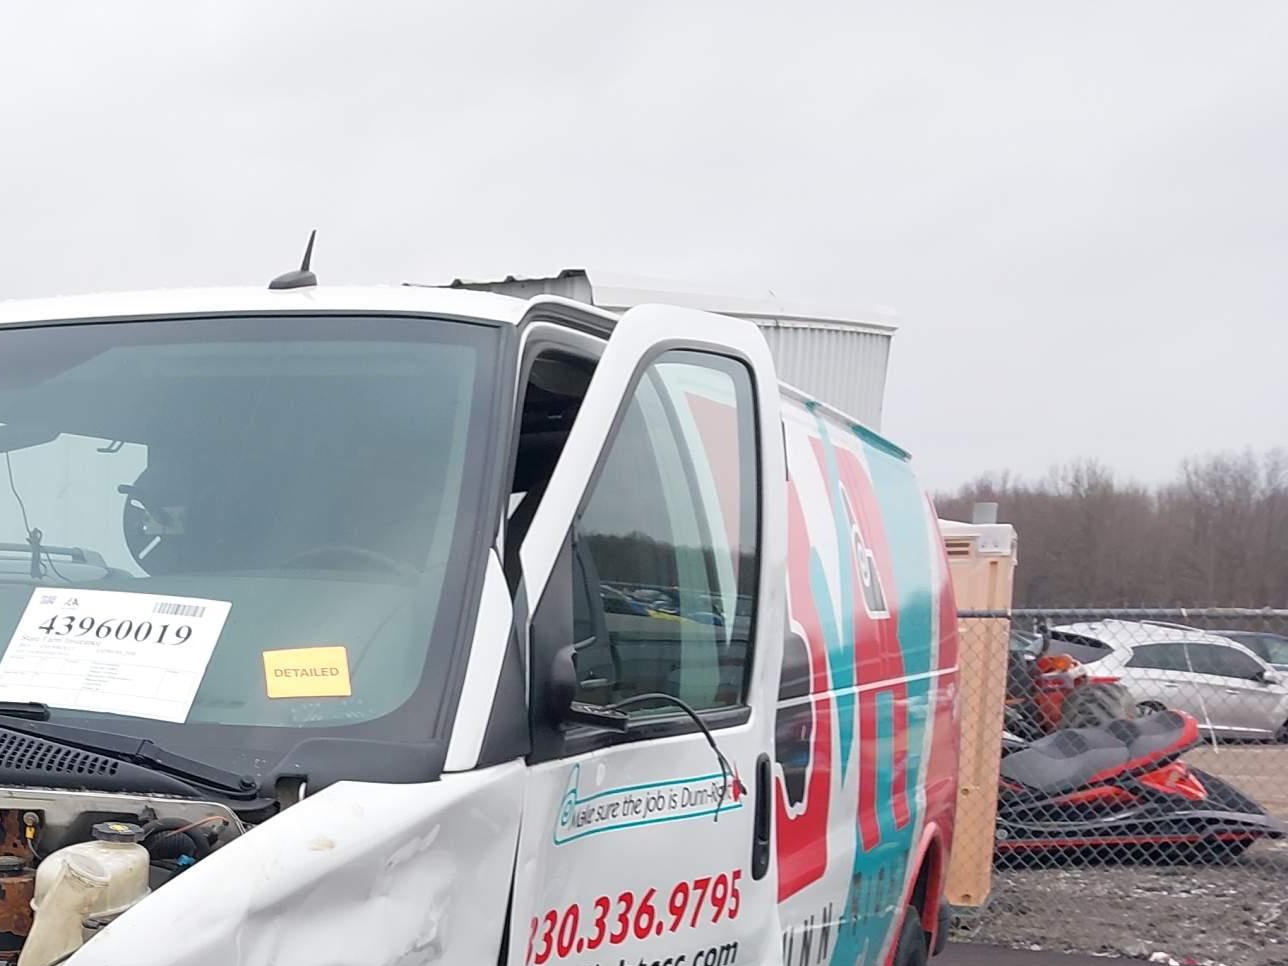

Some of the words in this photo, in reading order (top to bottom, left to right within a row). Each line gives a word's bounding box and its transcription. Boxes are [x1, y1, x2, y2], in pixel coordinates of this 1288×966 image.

[38, 614, 193, 646] 43960019
[273, 667, 340, 678] DETAILED
[595, 799, 619, 823] sure
[622, 793, 642, 818] the
[641, 788, 665, 820] job
[668, 788, 679, 810] is
